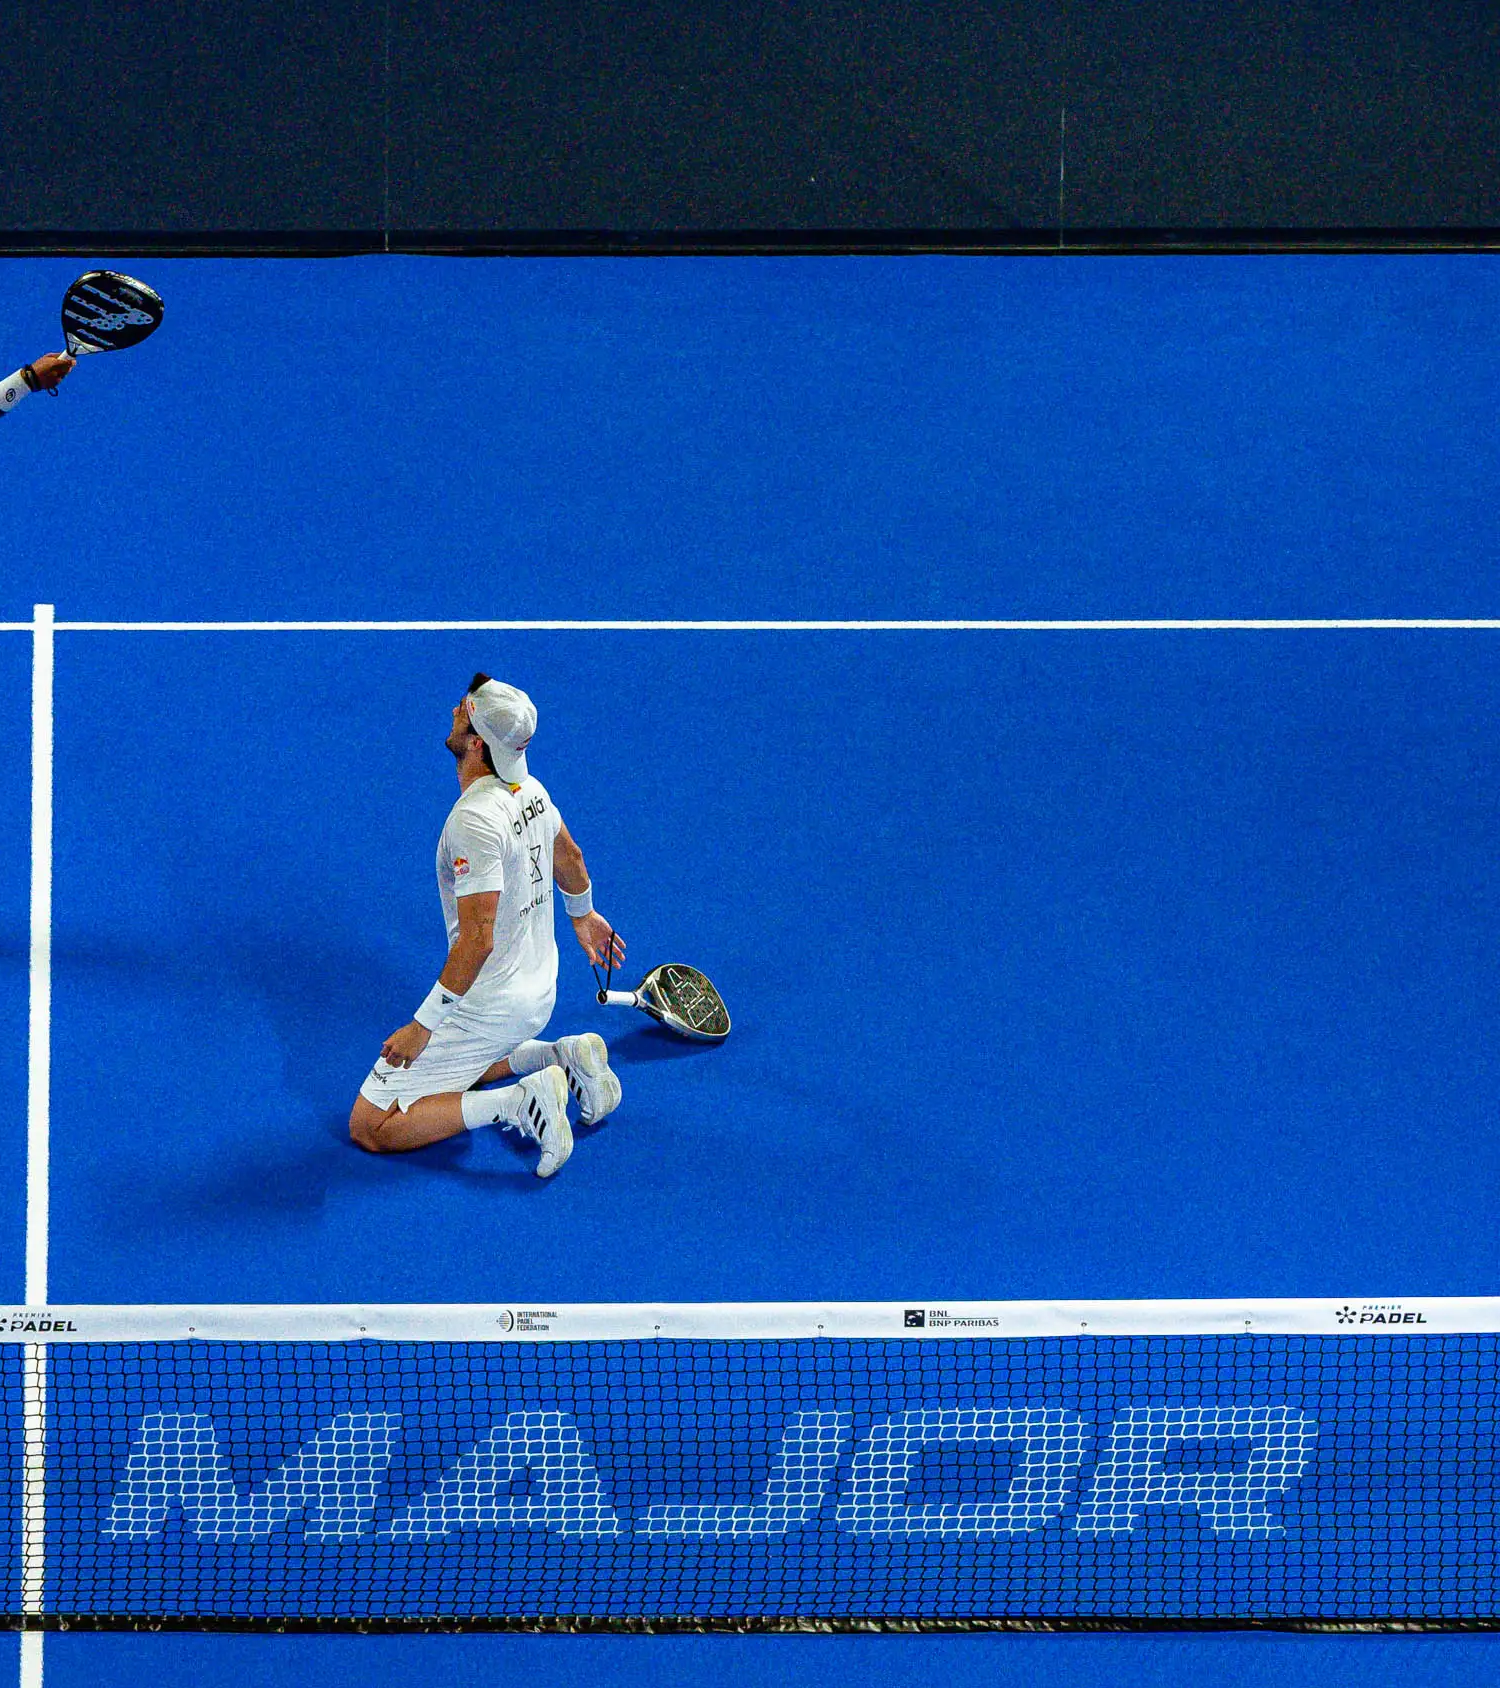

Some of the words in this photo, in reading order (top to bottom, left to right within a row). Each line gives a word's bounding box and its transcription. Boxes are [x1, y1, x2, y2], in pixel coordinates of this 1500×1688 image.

[929, 1310, 951, 1318] BNL
[1359, 1312, 1428, 1324] PADEL
[10, 1320, 78, 1332] PADEL
[929, 1319, 952, 1327] BNP
[953, 1319, 1000, 1327] PARIBAS
[100, 1404, 1319, 1541] MAJOR
